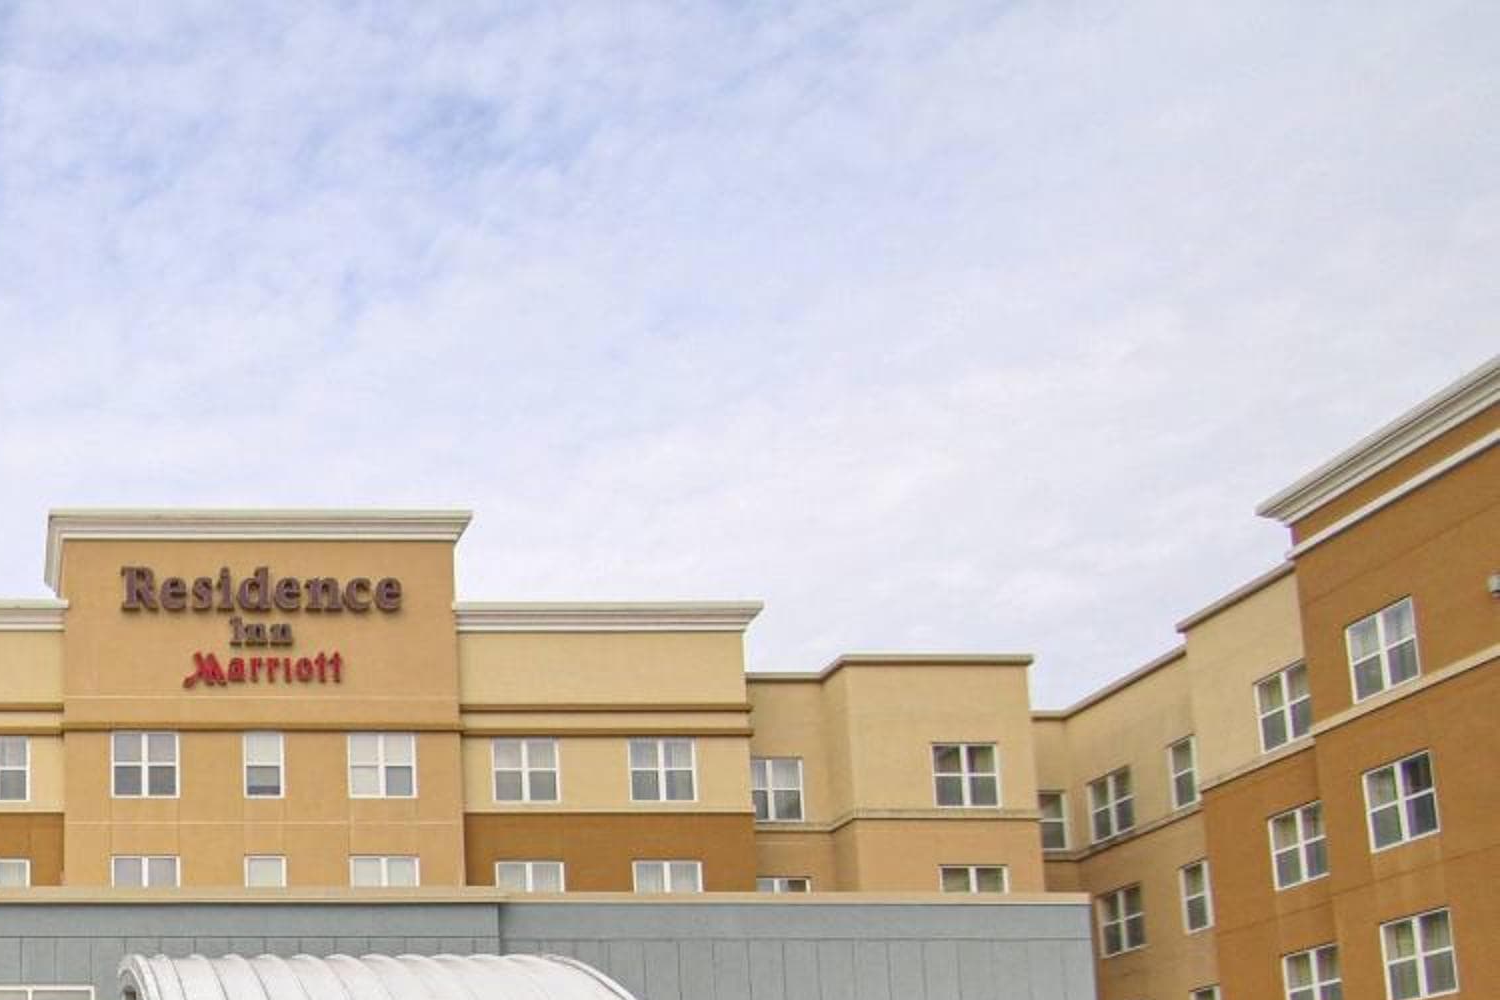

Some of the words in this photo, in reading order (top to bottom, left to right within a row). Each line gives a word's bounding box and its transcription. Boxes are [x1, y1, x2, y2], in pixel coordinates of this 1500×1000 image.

[120, 566, 403, 613] Residence
[229, 617, 294, 647] Inn
[182, 651, 343, 688] Marriott
